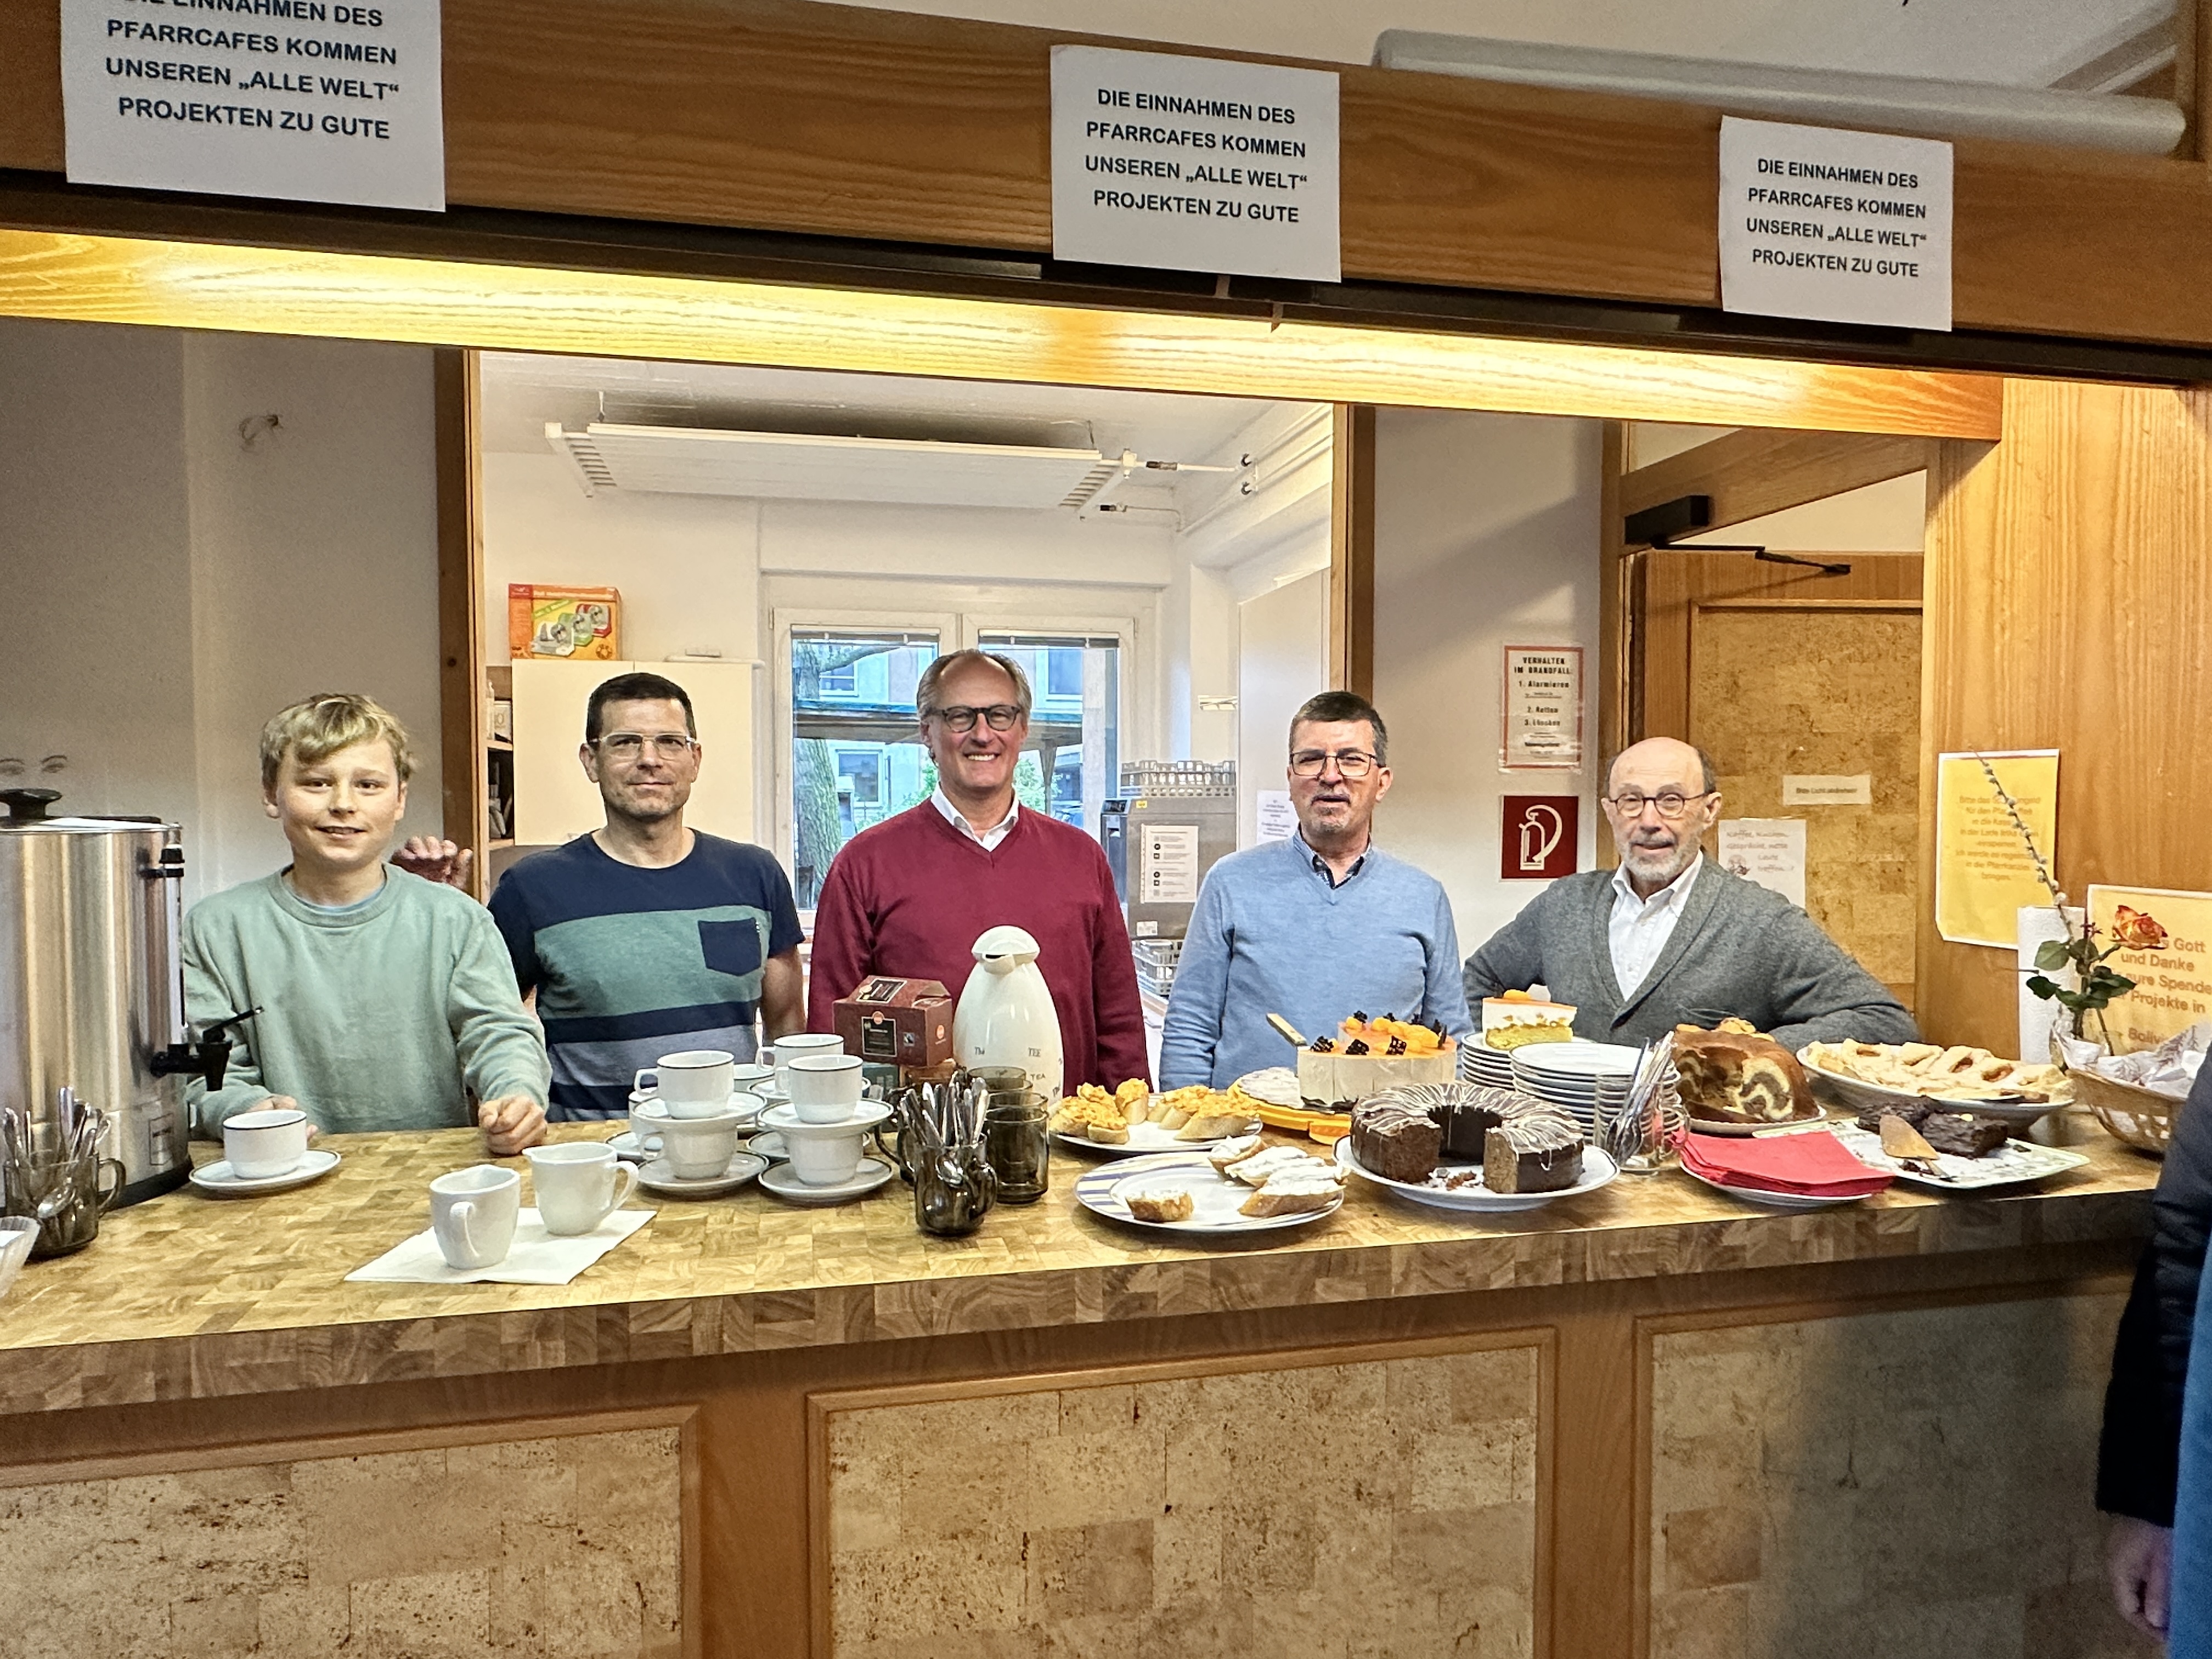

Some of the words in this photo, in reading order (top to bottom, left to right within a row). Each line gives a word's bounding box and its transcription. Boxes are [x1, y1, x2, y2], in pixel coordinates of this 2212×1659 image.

[334, 5, 382, 27] DES
[108, 19, 279, 53] PFARRCAFES
[286, 38, 396, 65] KOMMEN
[106, 57, 231, 86] UNSEREN
[238, 71, 313, 93] „ALLE
[319, 76, 399, 100] WELT“
[119, 97, 272, 128] PROJEKTEN
[280, 111, 313, 132] ZU
[321, 115, 390, 139] GUTE
[1098, 88, 1130, 107] DIE
[1136, 93, 1252, 121] EINNAHMEN
[1257, 106, 1295, 124] DES
[1086, 121, 1216, 149] PFARRCAFES
[1222, 134, 1306, 157] KOMMEN
[1085, 155, 1180, 179] UNSEREN
[1186, 165, 1242, 185] „ALLE
[1248, 170, 1308, 190] WELT“
[1758, 159, 1784, 174] DIE
[1788, 161, 1883, 185] EINNAHMEN
[1887, 172, 1918, 188] DES
[1094, 189, 1211, 216] PROJEKTEN
[1216, 201, 1242, 218] ZU
[1247, 204, 1299, 223] GUTE
[1748, 188, 1853, 211] PFARRCAFES
[1857, 199, 1926, 219] KOMMEN
[1746, 217, 1824, 238] UNSEREN
[1827, 226, 1874, 242] „ALLE
[1752, 249, 1847, 271] PROJEKTEN
[1851, 257, 1872, 273] ZU
[1876, 260, 1919, 277] GUTE
[1522, 657, 1565, 665] VERHALTEN
[1528, 667, 1570, 675] BRANDFALL
[2174, 937, 2206, 953] Gott
[2120, 953, 2146, 965] und
[2149, 953, 2194, 972] Danke
[2131, 990, 2188, 1011] Projekte
[2193, 999, 2206, 1014] in
